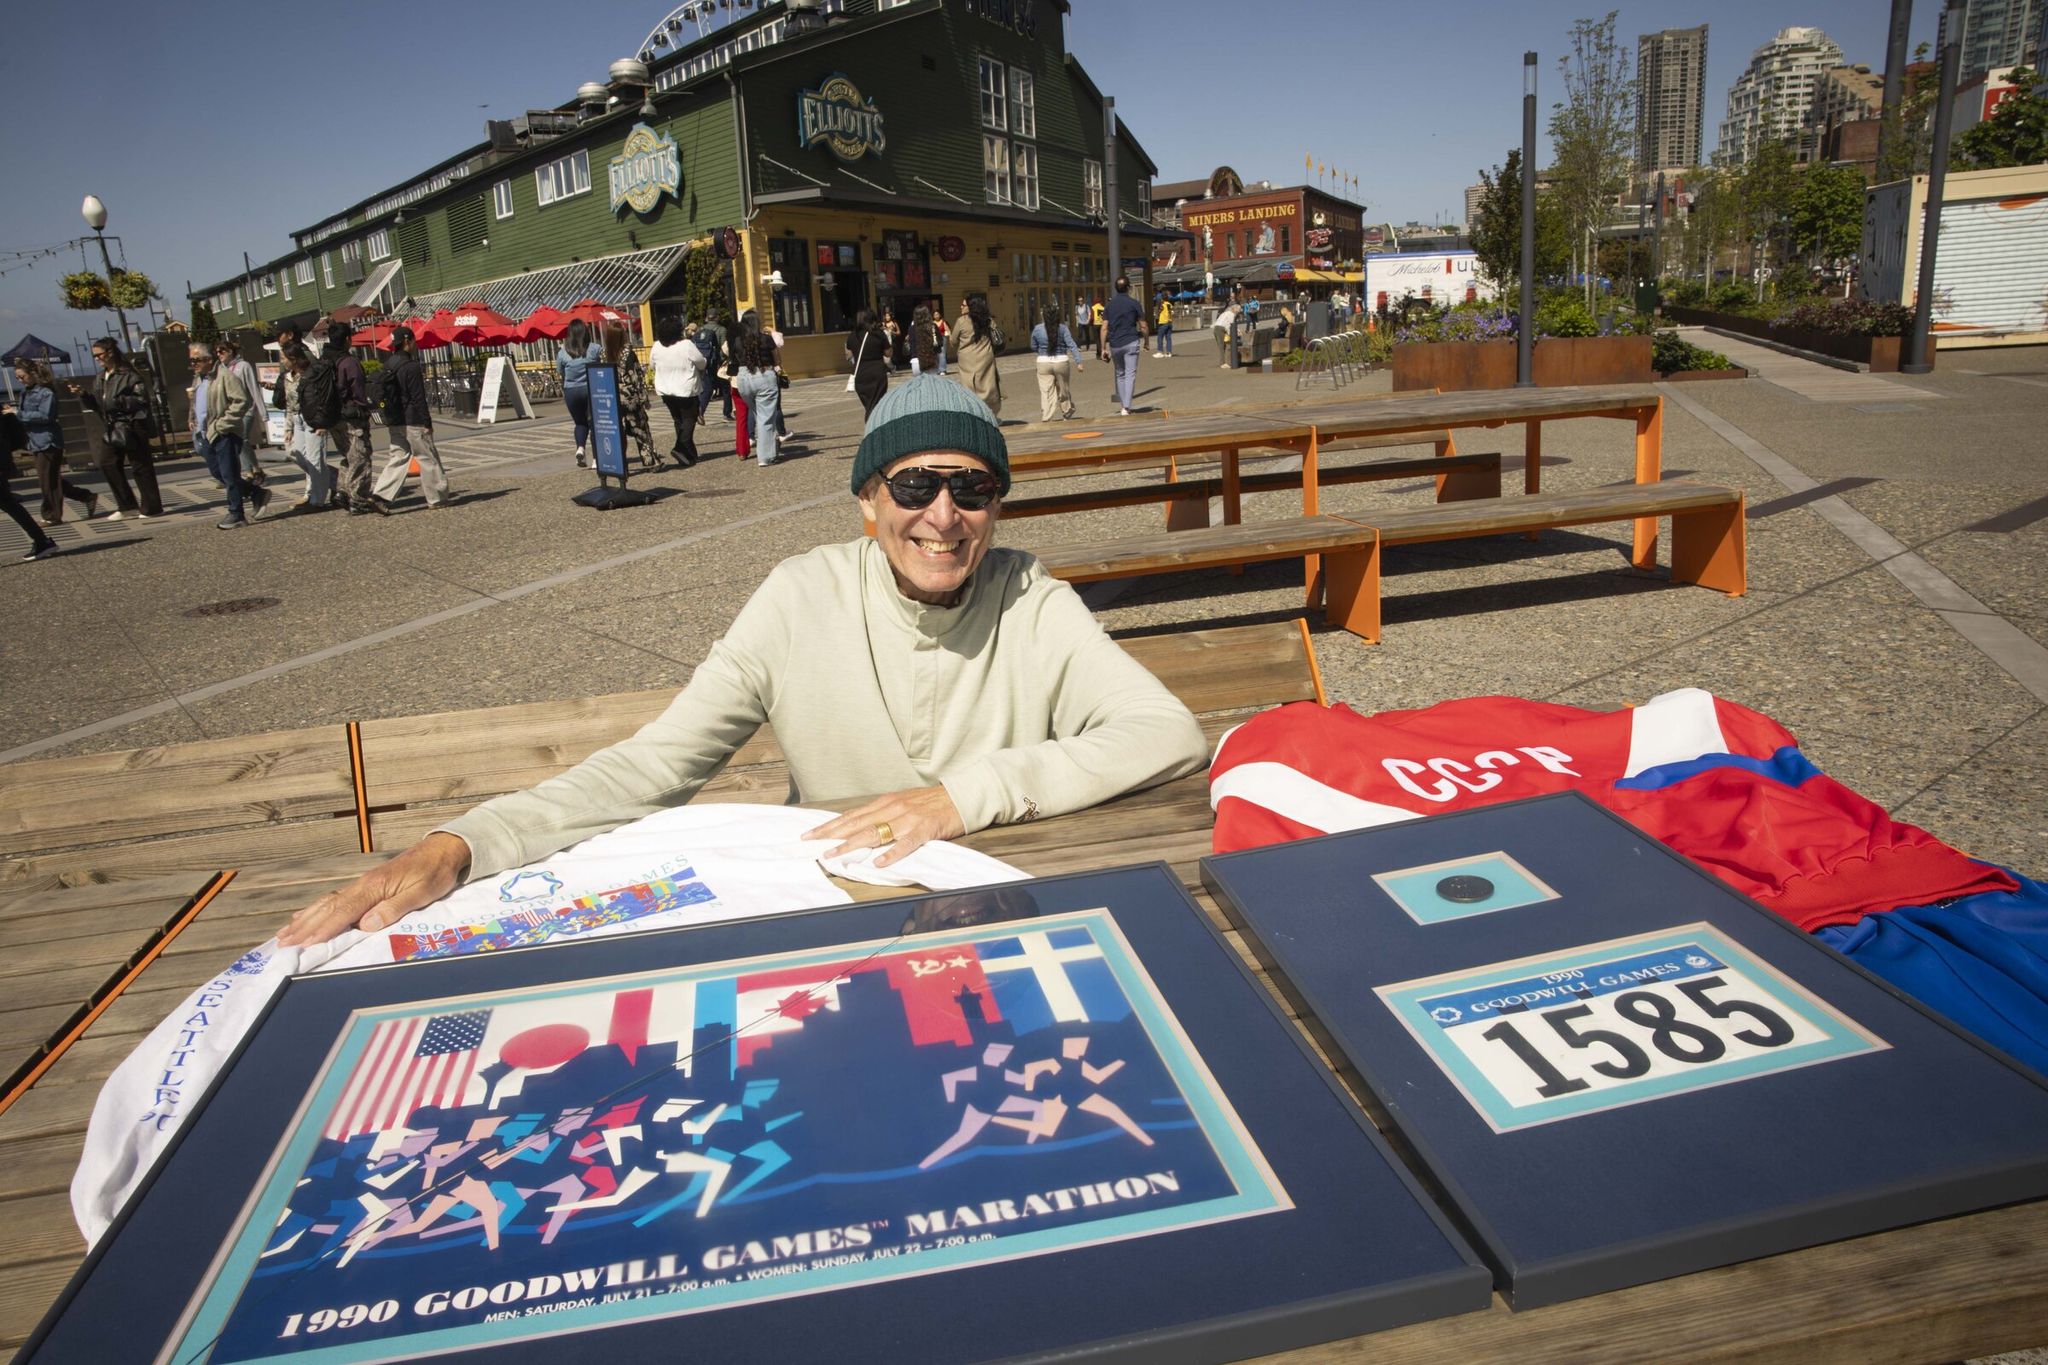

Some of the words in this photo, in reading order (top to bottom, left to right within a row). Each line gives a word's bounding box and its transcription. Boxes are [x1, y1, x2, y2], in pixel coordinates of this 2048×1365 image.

[1188, 211, 1235, 227] MINERS
[1238, 203, 1296, 222] LANDING
[1457, 260, 1479, 272] UL
[608, 853, 689, 891] GAMES
[1470, 979, 1598, 1013] GOODWILL
[1598, 961, 1682, 987] GAMES
[1540, 967, 1585, 986] 1990
[1482, 975, 1795, 1099] 1585
[277, 1298, 400, 1339] 1990
[413, 1253, 688, 1317] GOODWILL
[905, 1170, 1181, 1238] MARATHON
[483, 1309, 521, 1324] MEN:
[524, 1297, 597, 1318] SATURDAY,
[600, 1291, 633, 1306] JULY
[634, 1287, 652, 1301] 21
[667, 1280, 699, 1296] 7:00
[701, 1277, 731, 1290] a.m.
[747, 1263, 808, 1282] WOMEN:
[811, 1251, 869, 1271] SUNDAY,
[871, 1245, 901, 1262] JULY
[904, 1242, 922, 1255] 22
[936, 1236, 966, 1250] 7:00
[968, 1231, 998, 1245] a.m.
